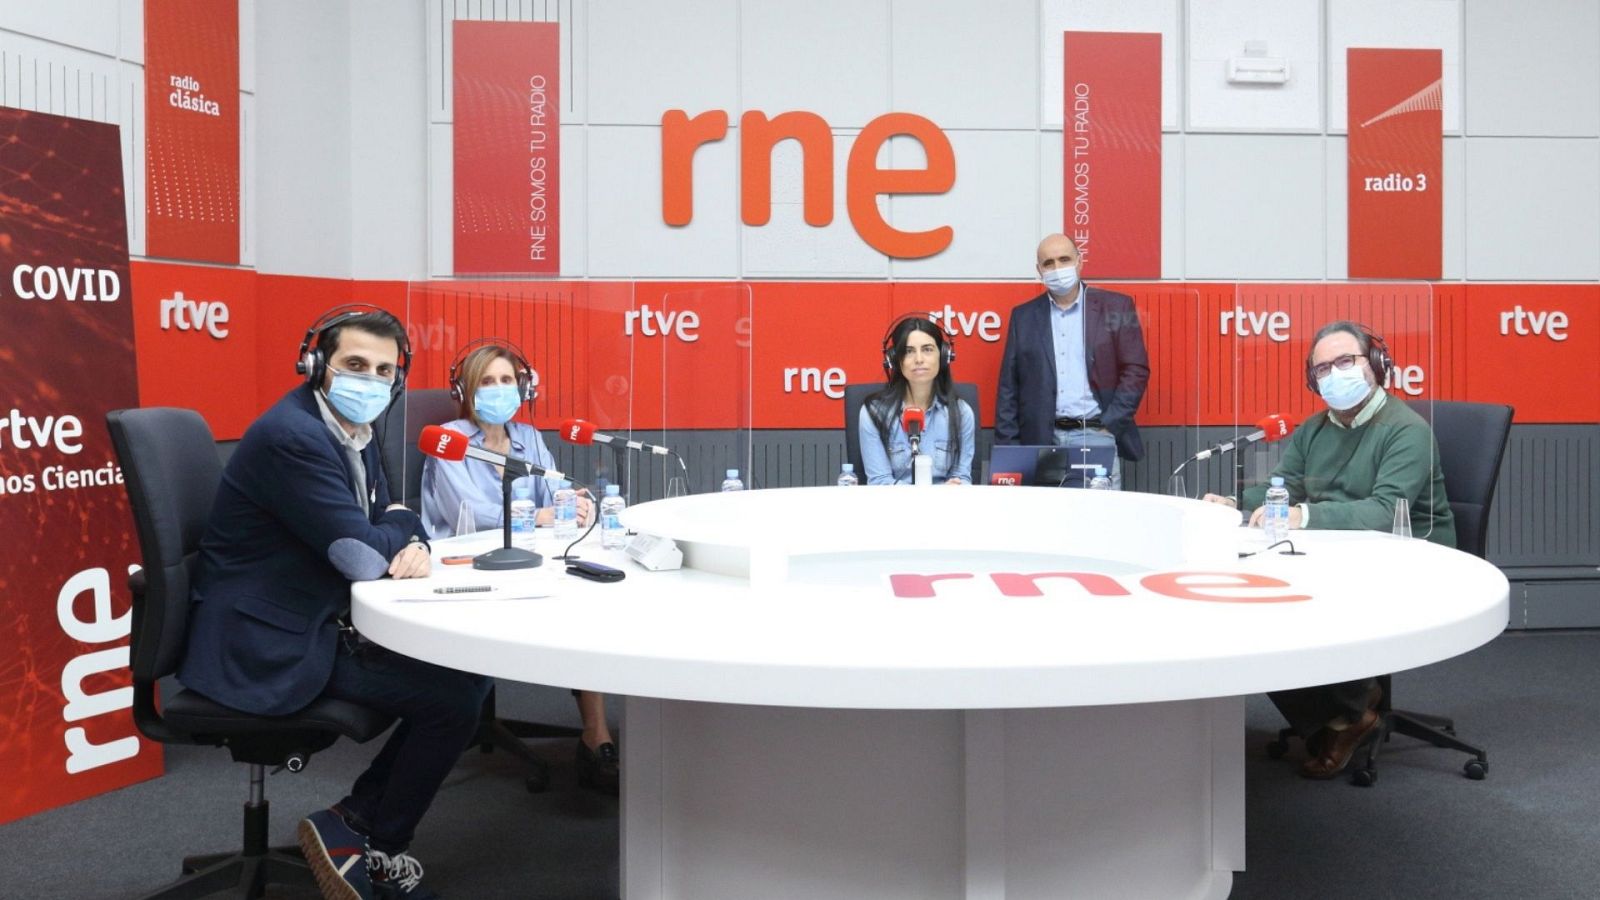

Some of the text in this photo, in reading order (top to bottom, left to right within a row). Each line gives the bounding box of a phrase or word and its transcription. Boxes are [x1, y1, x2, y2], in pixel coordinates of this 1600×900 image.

[169, 88, 220, 116] clásica
[170, 75, 200, 92] radio
[1074, 82, 1089, 132] RADIO
[1074, 137, 1089, 158] TU
[530, 74, 546, 260] RNE SOMOS TU RADIO
[661, 109, 956, 260] rne
[1364, 173, 1427, 192] radio 3
[1074, 162, 1089, 225] SOMOS
[12, 264, 120, 302] COVID
[160, 291, 229, 339] rtve
[624, 304, 700, 342] rtve
[929, 304, 1001, 342] rtve
[1220, 305, 1290, 342] rtve
[1500, 305, 1569, 341] rtve
[784, 366, 847, 399] rne
[1384, 365, 1424, 395] ne
[435, 434, 452, 454] rne
[889, 571, 1314, 604] rne
[57, 563, 143, 775] rne
